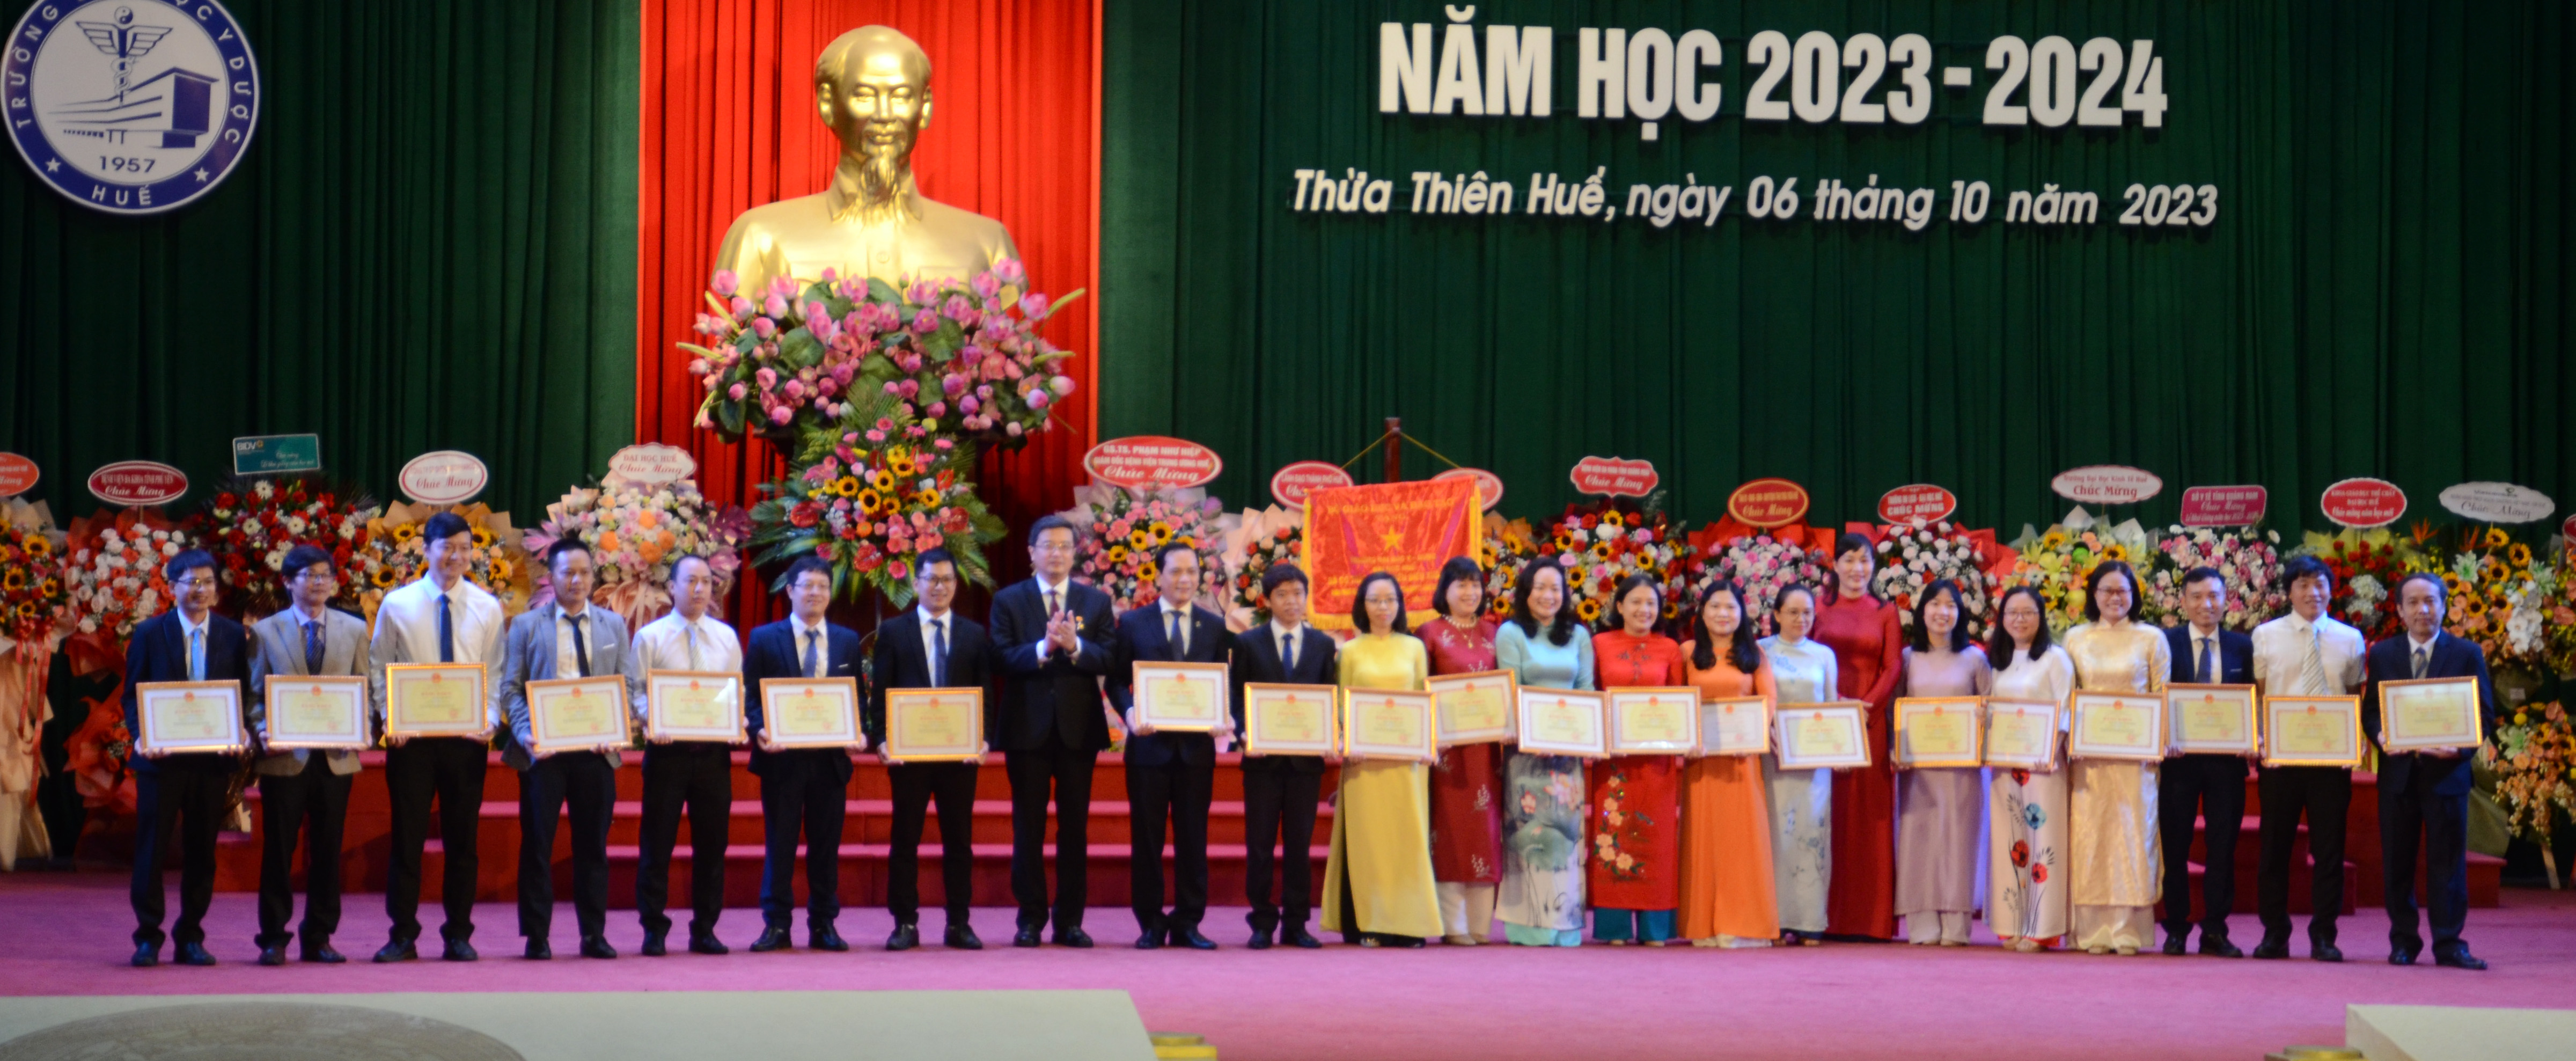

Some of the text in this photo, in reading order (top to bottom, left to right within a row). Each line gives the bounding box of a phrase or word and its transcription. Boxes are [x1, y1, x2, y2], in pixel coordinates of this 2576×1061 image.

[9, 5, 58, 129] TRƯỜNG
[1379, 4, 1552, 117] NĂM
[1578, 27, 1722, 141] HỌC
[1745, 30, 1932, 123] 2023
[1982, 35, 2168, 128] 2024
[99, 156, 156, 173] 1957
[92, 185, 152, 207] HUẾ
[1293, 165, 2218, 231] Thừa Thiên Huế, ngày 06 tháng 10 năm 2023
[641, 455, 657, 463] HỌC
[660, 453, 677, 462] HUẾ
[1133, 445, 1159, 456] PHẠM
[1161, 447, 1180, 456] NHƯ
[1181, 446, 1202, 457] HIỆP
[619, 463, 647, 472] Chúc
[1104, 465, 1199, 482] Chúc Mừng
[416, 478, 441, 489] Chúc
[1585, 474, 1643, 491] Chúc Mừng
[2074, 485, 2138, 498] Chúc Mừng
[1887, 502, 1944, 516] CHÚC MỪNG
[2461, 501, 2531, 519] Chúc Mừng
